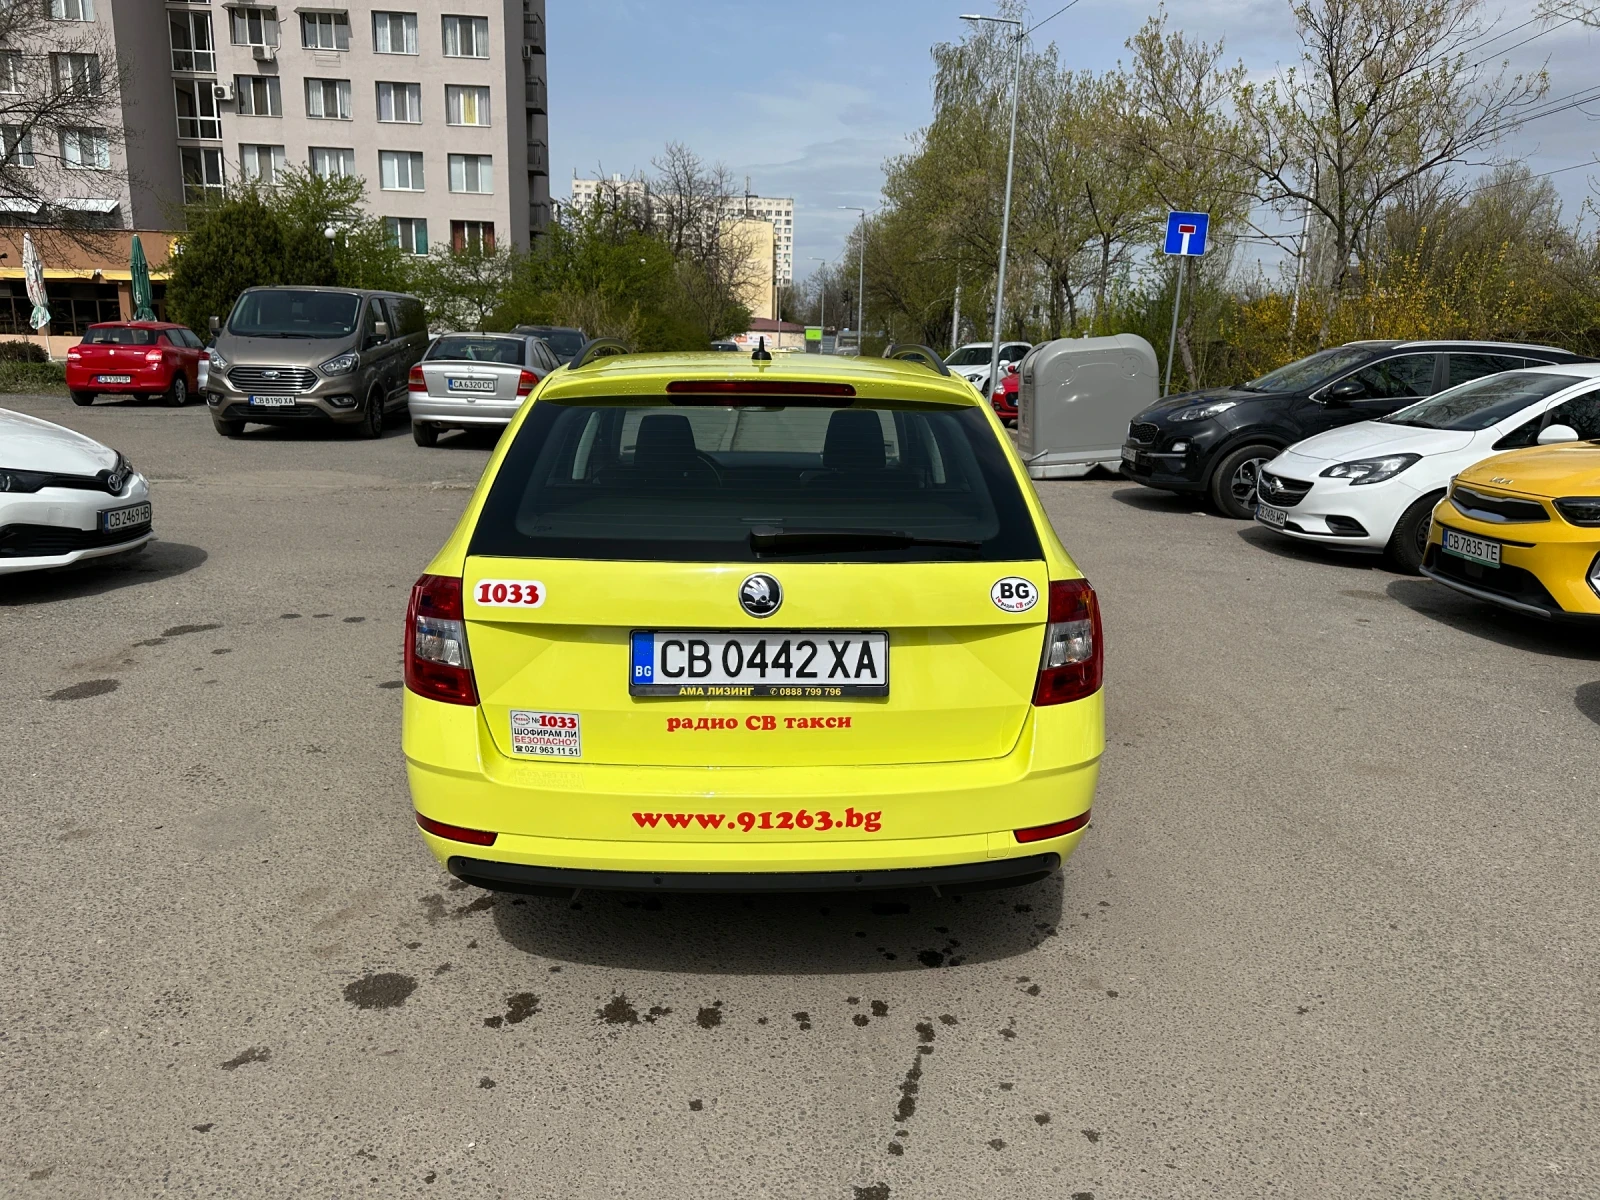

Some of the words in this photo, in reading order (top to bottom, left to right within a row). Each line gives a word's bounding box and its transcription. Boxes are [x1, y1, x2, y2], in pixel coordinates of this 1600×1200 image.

[454, 380, 464, 388] CA
[464, 380, 481, 389] 6320
[482, 381, 493, 389] CC
[110, 512, 120, 527] CB
[122, 508, 139, 525] 2469
[141, 506, 150, 521] HB
[1448, 533, 1459, 550] CB
[1460, 537, 1483, 556] 7835
[1485, 543, 1498, 561] TE
[477, 583, 540, 605] 1033
[1000, 582, 1030, 599] BG
[660, 639, 712, 678] CB
[721, 639, 818, 678] 0442
[827, 640, 878, 678] XA
[635, 665, 652, 677] BG
[678, 687, 704, 696] АМА
[707, 687, 755, 696] ЛИЗИНГ
[779, 687, 803, 696] 0888
[804, 687, 822, 696] 799
[824, 687, 842, 696] 796
[666, 717, 739, 732] радио
[783, 716, 852, 729] такси
[513, 727, 562, 738] ШОФИРАМ
[564, 730, 577, 738] ЛИ
[514, 735, 578, 746] БЕЗОПАСНО?
[539, 746, 555, 754] 963
[556, 747, 566, 755] 11
[568, 747, 578, 755] 51
[631, 807, 882, 832] www.91263.bg
